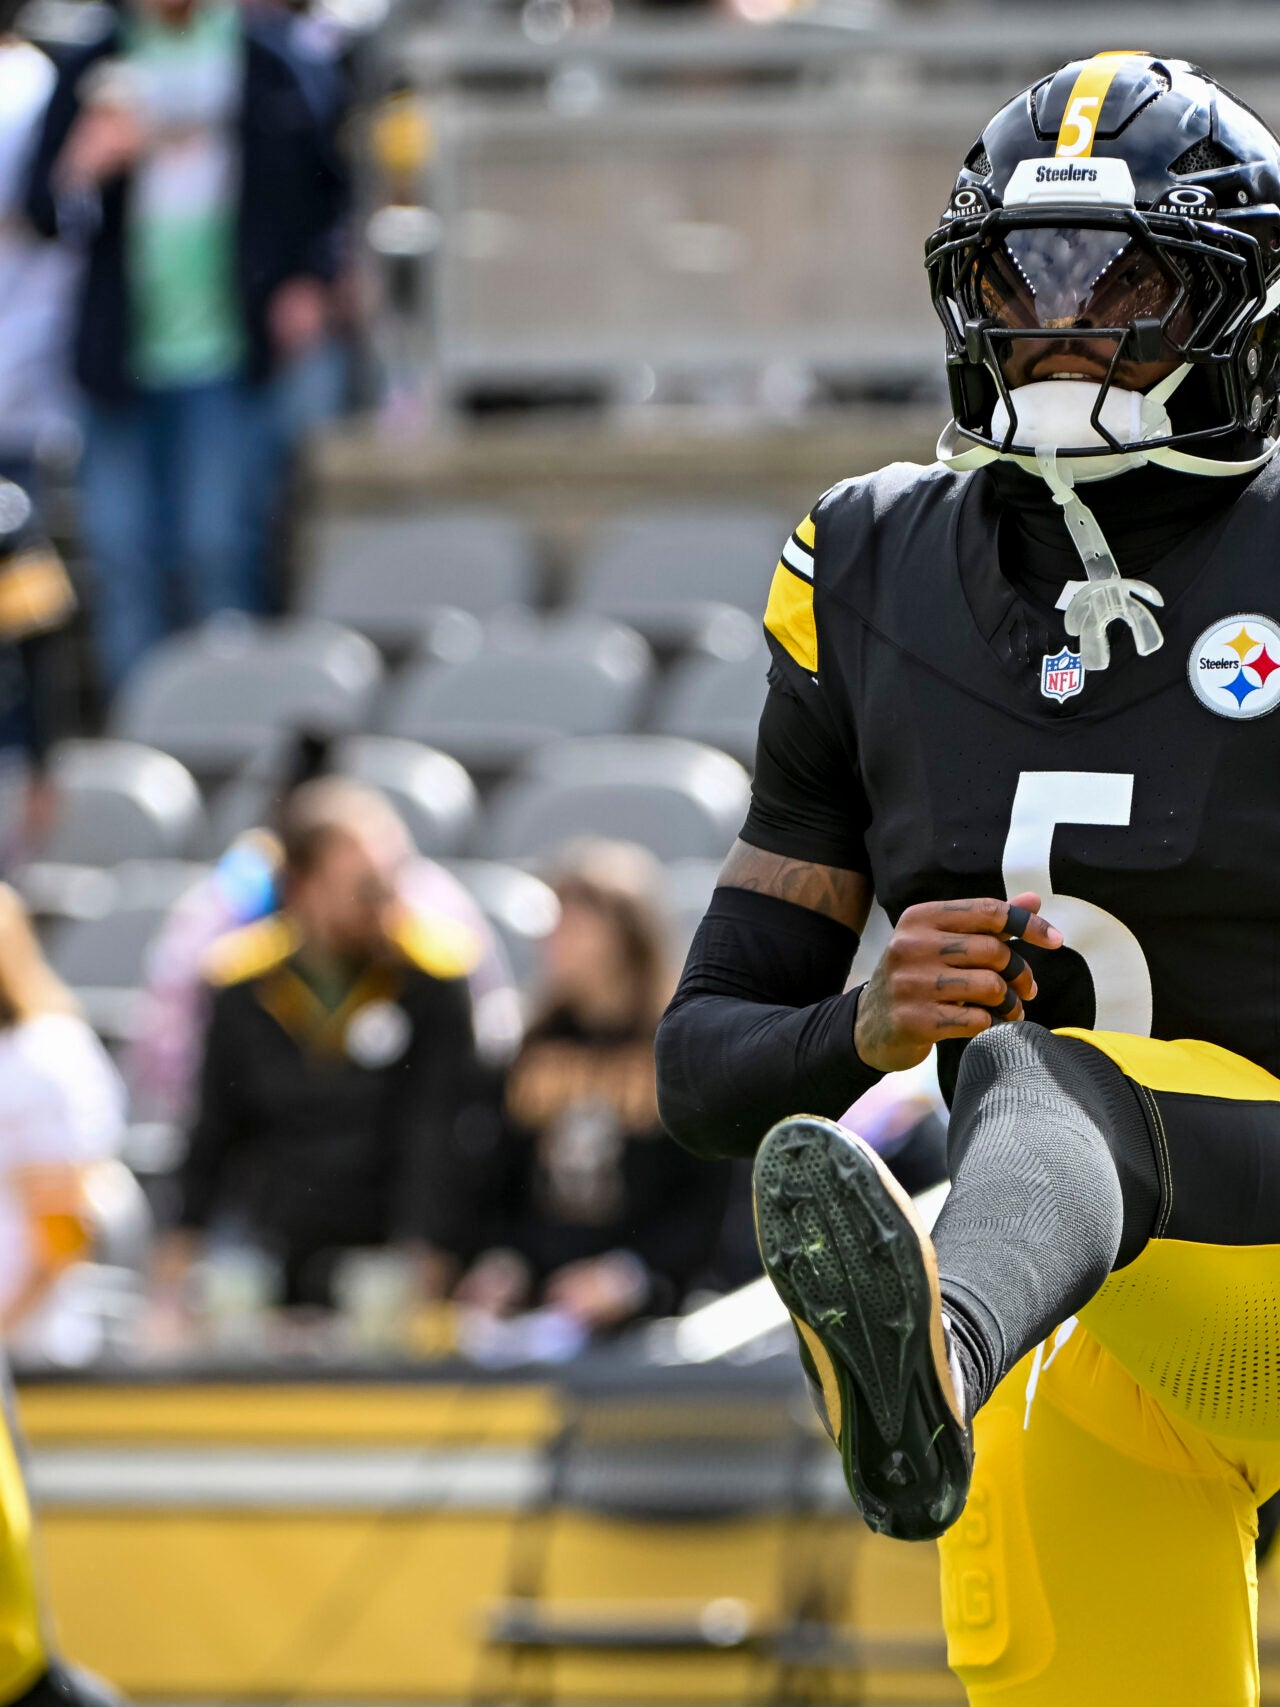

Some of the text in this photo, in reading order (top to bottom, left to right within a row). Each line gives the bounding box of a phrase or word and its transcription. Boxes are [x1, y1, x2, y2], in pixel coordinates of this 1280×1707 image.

[1057, 96, 1099, 157] 5
[1035, 163, 1098, 183] Steelers
[952, 204, 983, 219] OAKLEY
[1158, 204, 1215, 216] OAKLEY
[1199, 657, 1240, 670] Steelers
[1047, 670, 1078, 692] NFL
[1002, 771, 1153, 1038] 5
